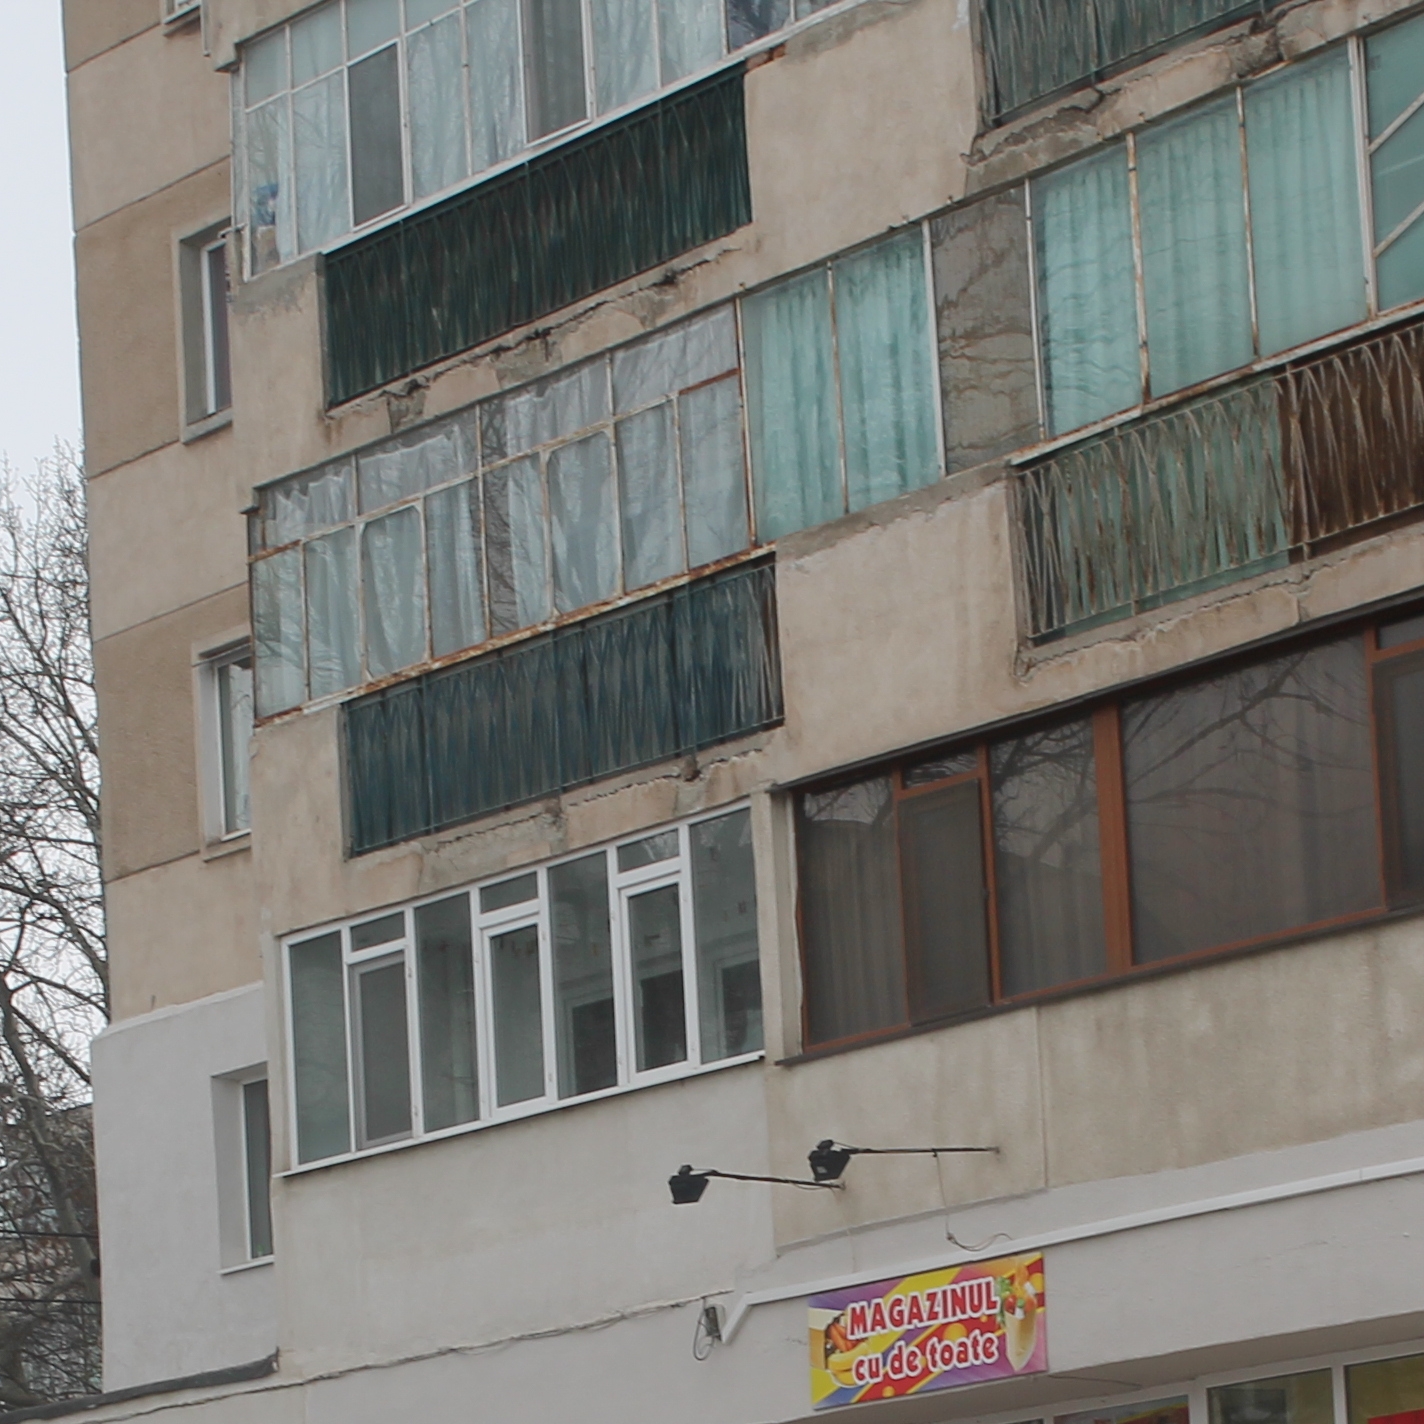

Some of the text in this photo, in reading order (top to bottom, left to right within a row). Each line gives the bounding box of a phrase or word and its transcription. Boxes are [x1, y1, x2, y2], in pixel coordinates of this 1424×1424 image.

[848, 1279, 1000, 1337] MAGAZINUL
[854, 1333, 997, 1382] cu de toate
